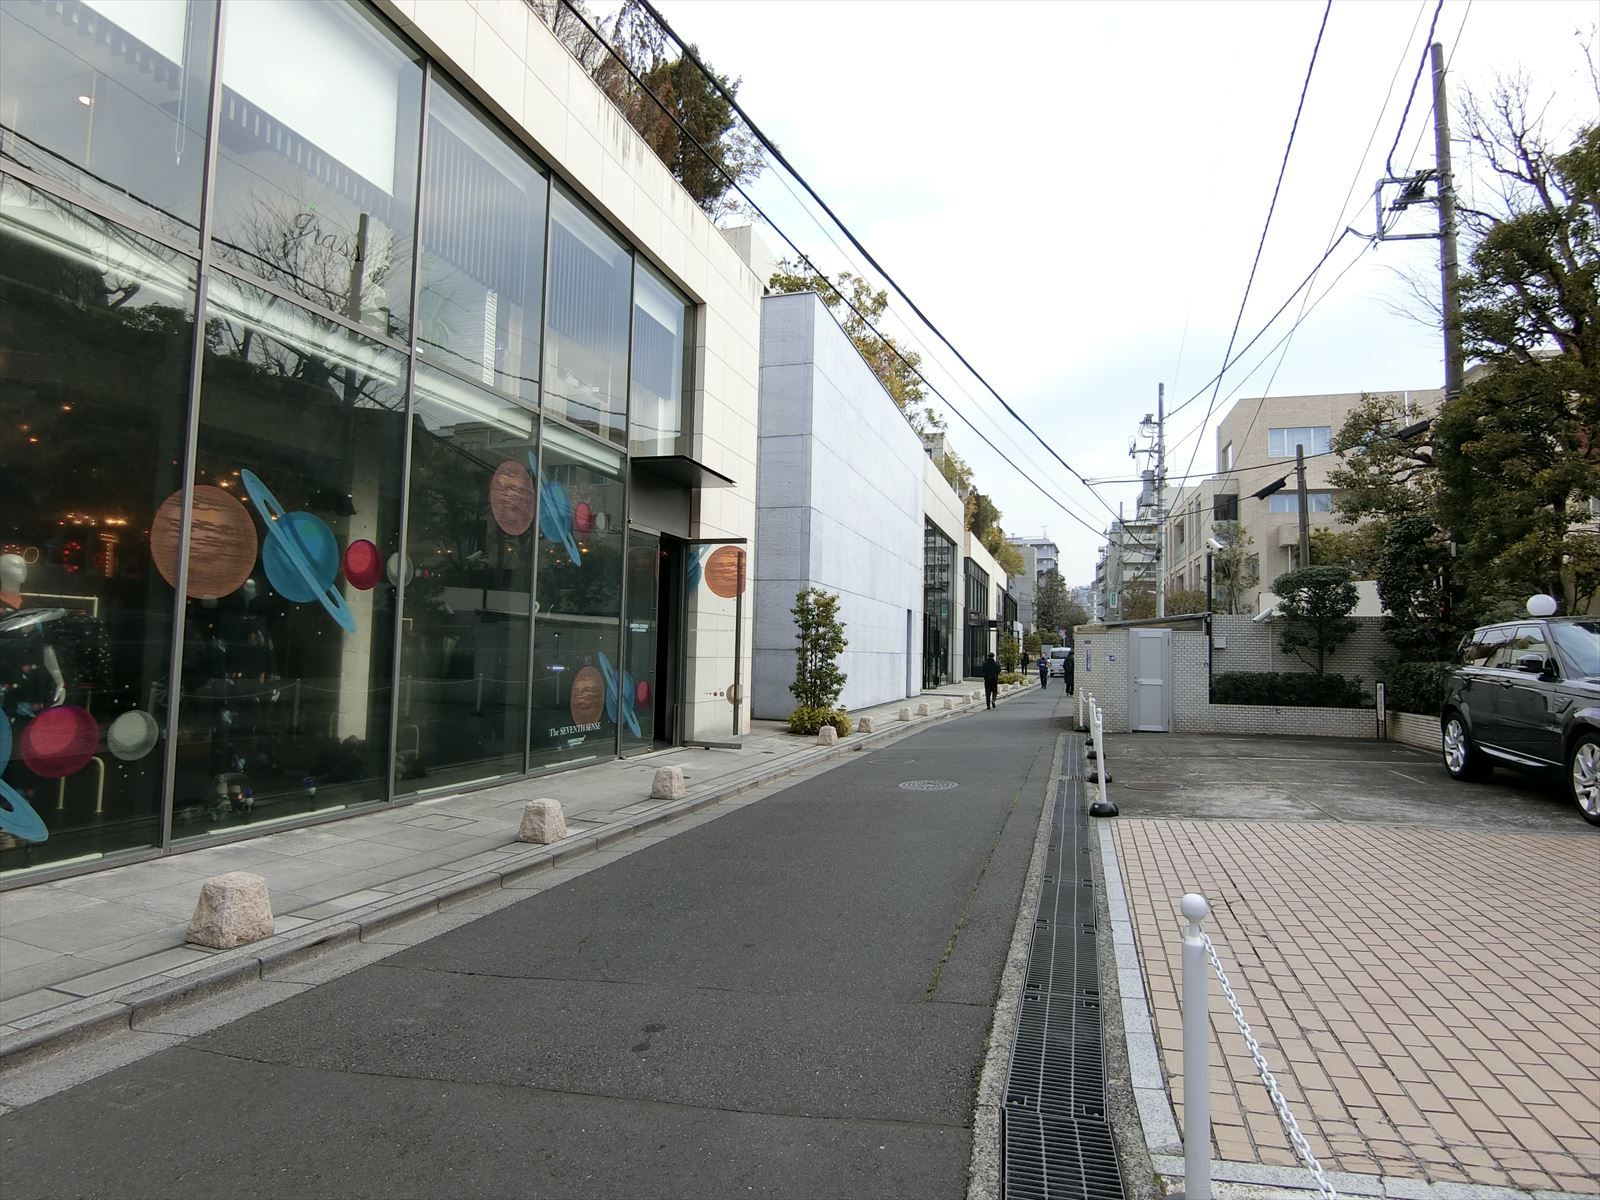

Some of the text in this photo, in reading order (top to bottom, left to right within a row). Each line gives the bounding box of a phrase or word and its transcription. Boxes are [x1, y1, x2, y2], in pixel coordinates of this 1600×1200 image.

[549, 721, 602, 737] The SEVENTH SENSE
